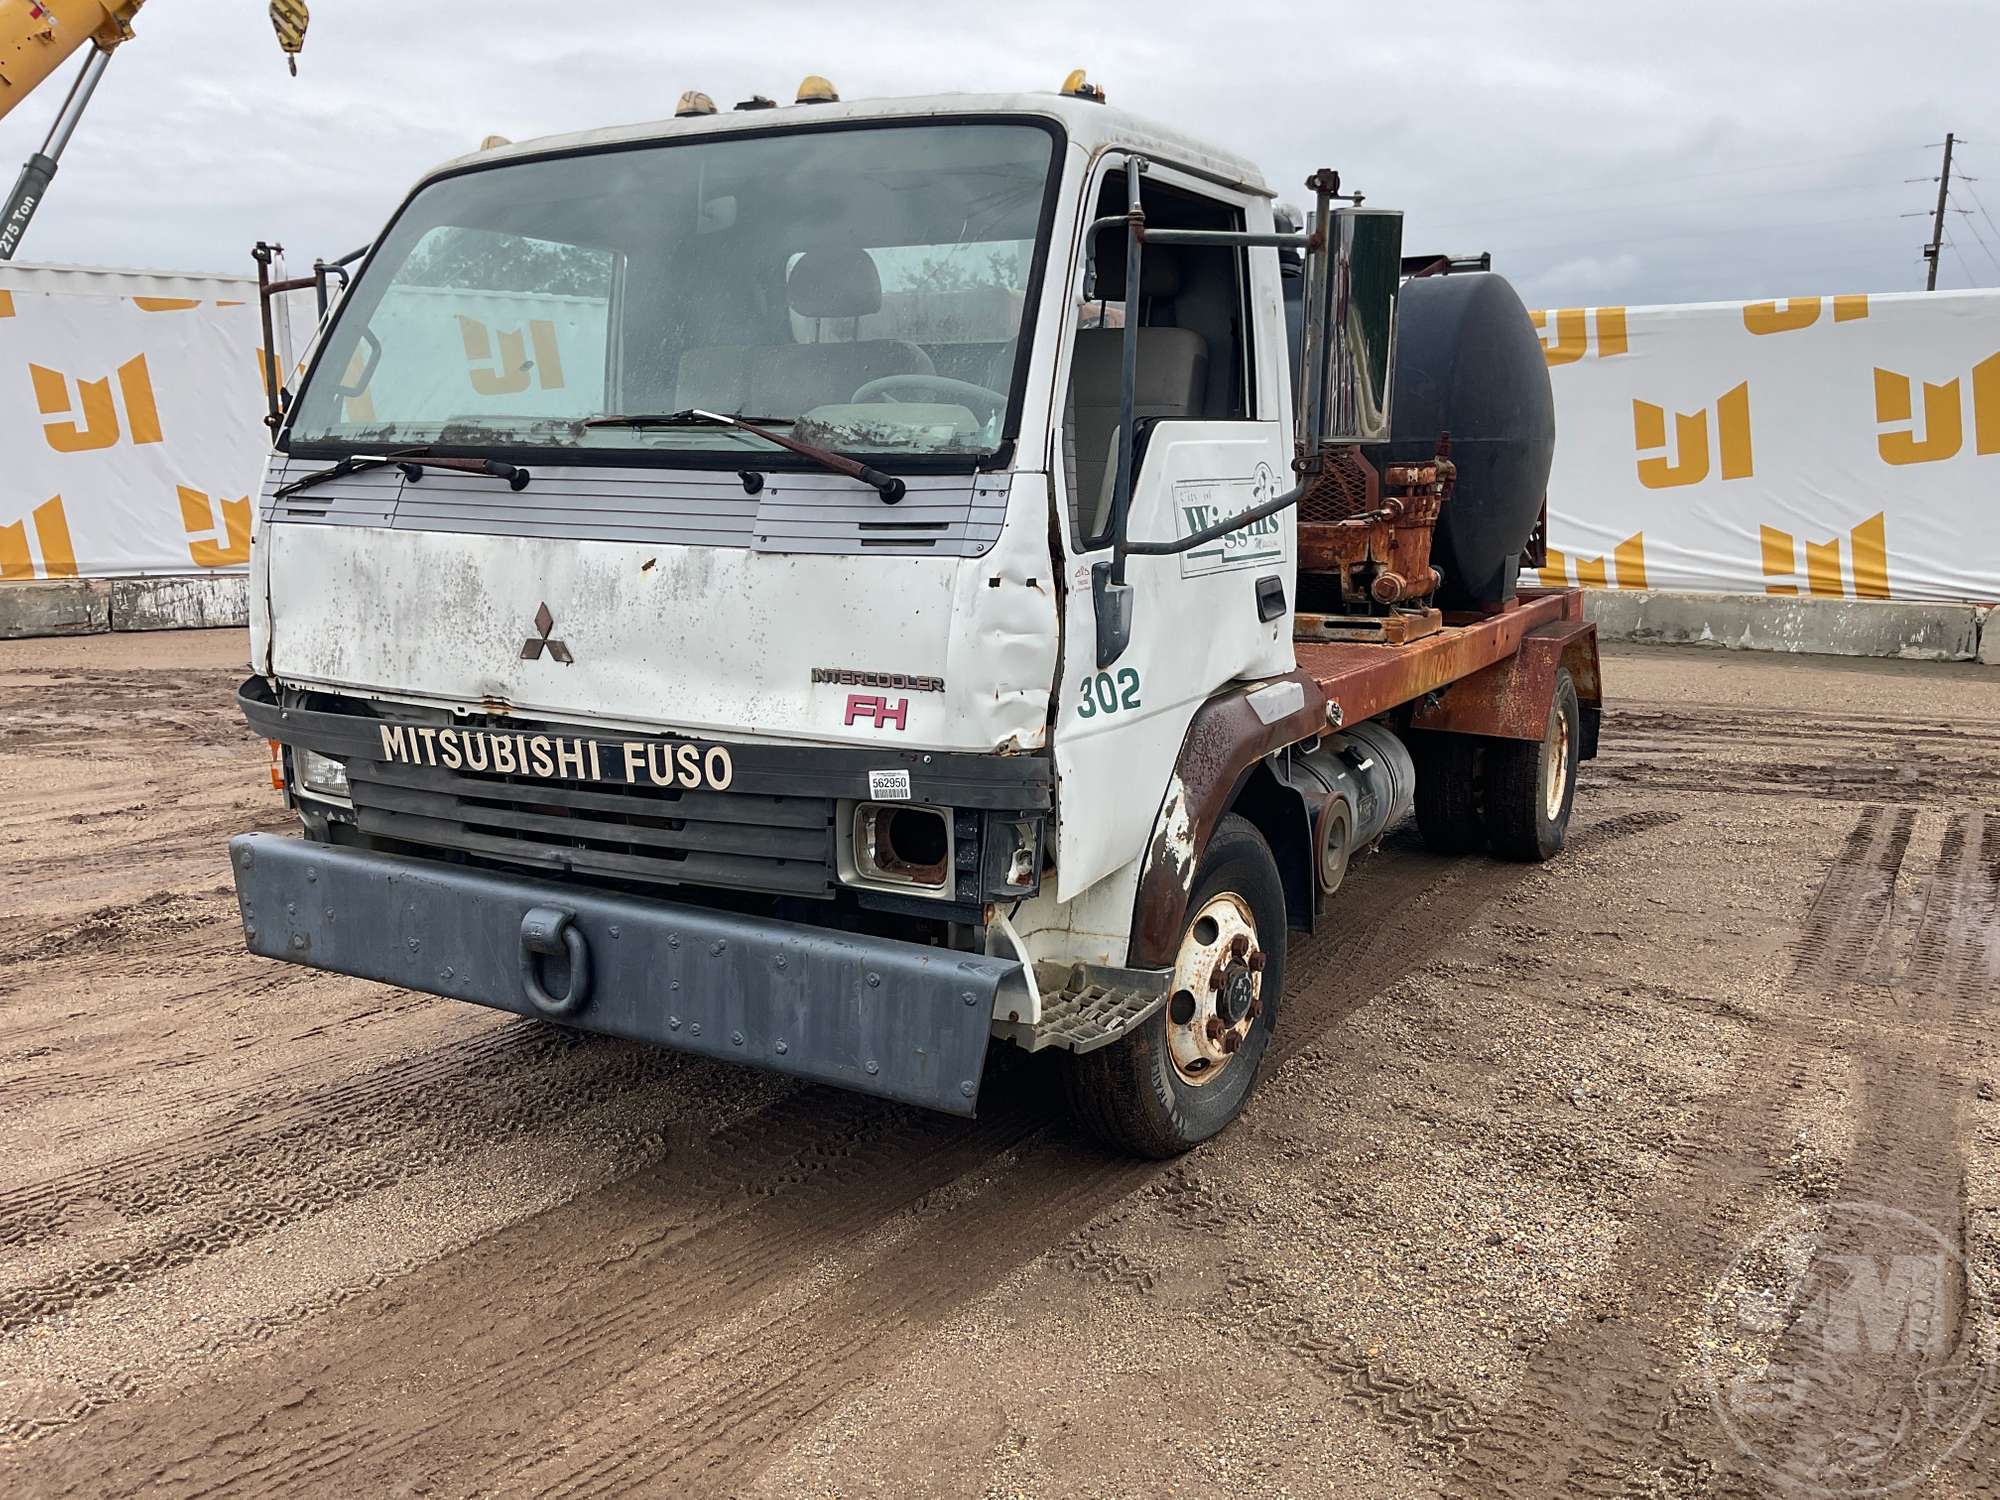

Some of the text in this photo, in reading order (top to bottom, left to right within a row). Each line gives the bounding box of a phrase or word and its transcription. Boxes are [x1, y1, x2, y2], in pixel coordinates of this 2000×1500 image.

[0, 196, 35, 253] 275 Ton
[811, 667, 945, 692] INTERCOOLER
[1077, 667, 1142, 719] 302
[844, 694, 909, 731] FH
[379, 724, 734, 791] MITSUBISHI FUSO
[872, 777, 907, 788] 562950
